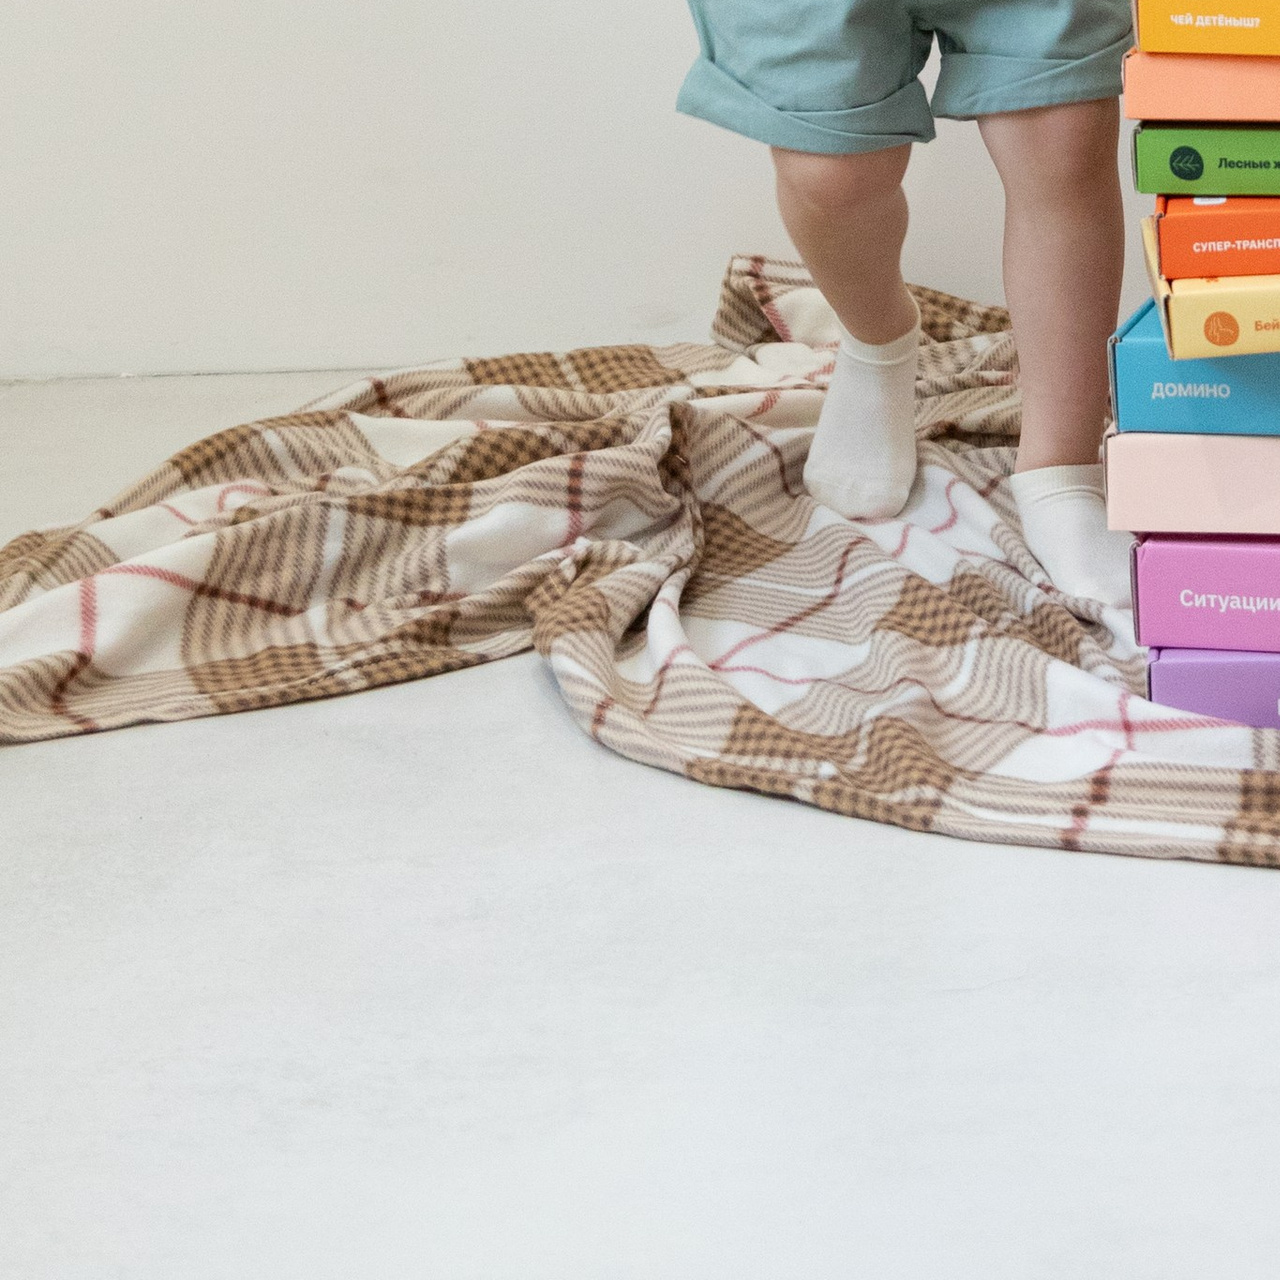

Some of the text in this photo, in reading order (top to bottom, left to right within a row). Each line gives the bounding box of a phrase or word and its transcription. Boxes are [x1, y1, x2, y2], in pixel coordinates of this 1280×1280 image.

[1170, 13, 1261, 29] ЧЕЙ ДЕТЁНЫШ?
[1218, 158, 1270, 170] Лесные
[1152, 382, 1230, 400] ДОМИНО
